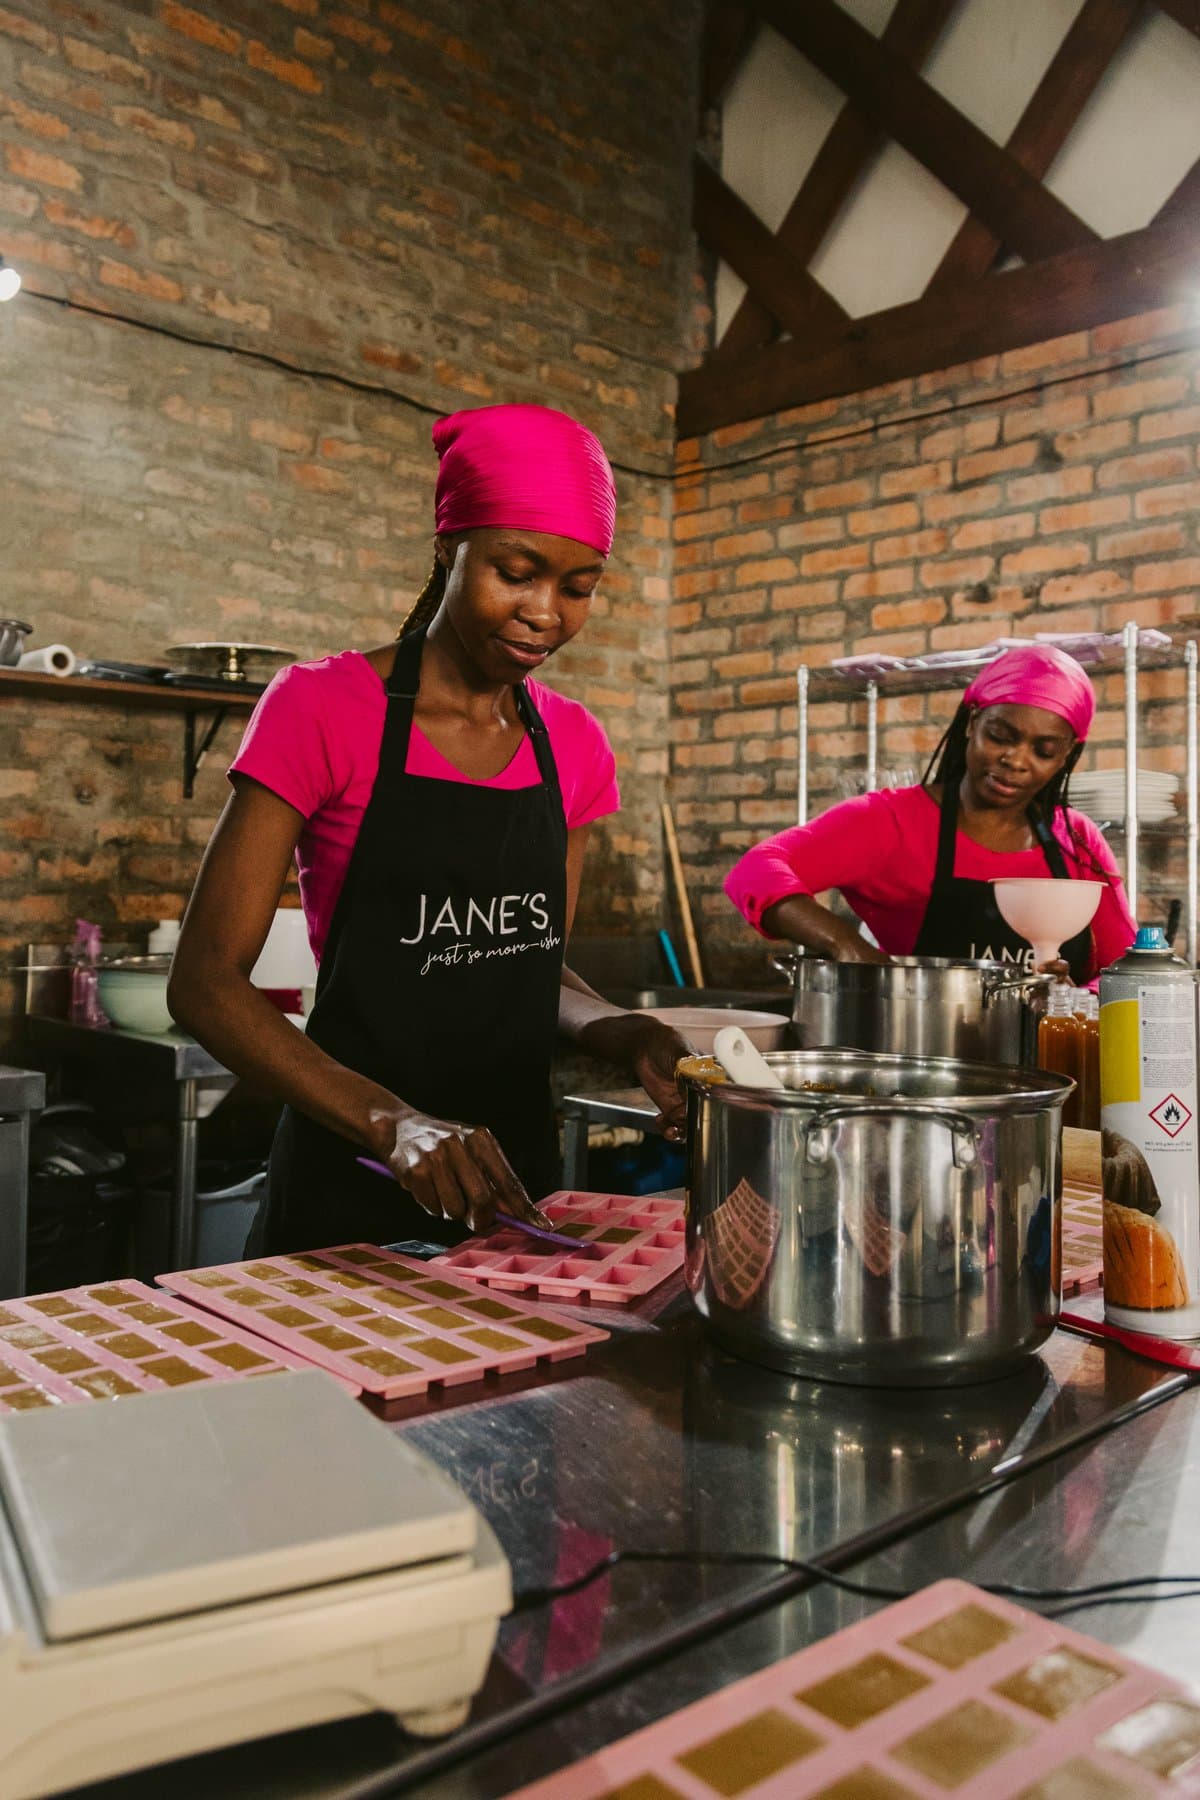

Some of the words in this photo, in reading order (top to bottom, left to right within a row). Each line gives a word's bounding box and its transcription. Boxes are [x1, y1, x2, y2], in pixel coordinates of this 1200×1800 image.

[400, 892, 549, 945] JANE'S
[420, 942, 471, 976] just
[468, 949, 483, 964] so
